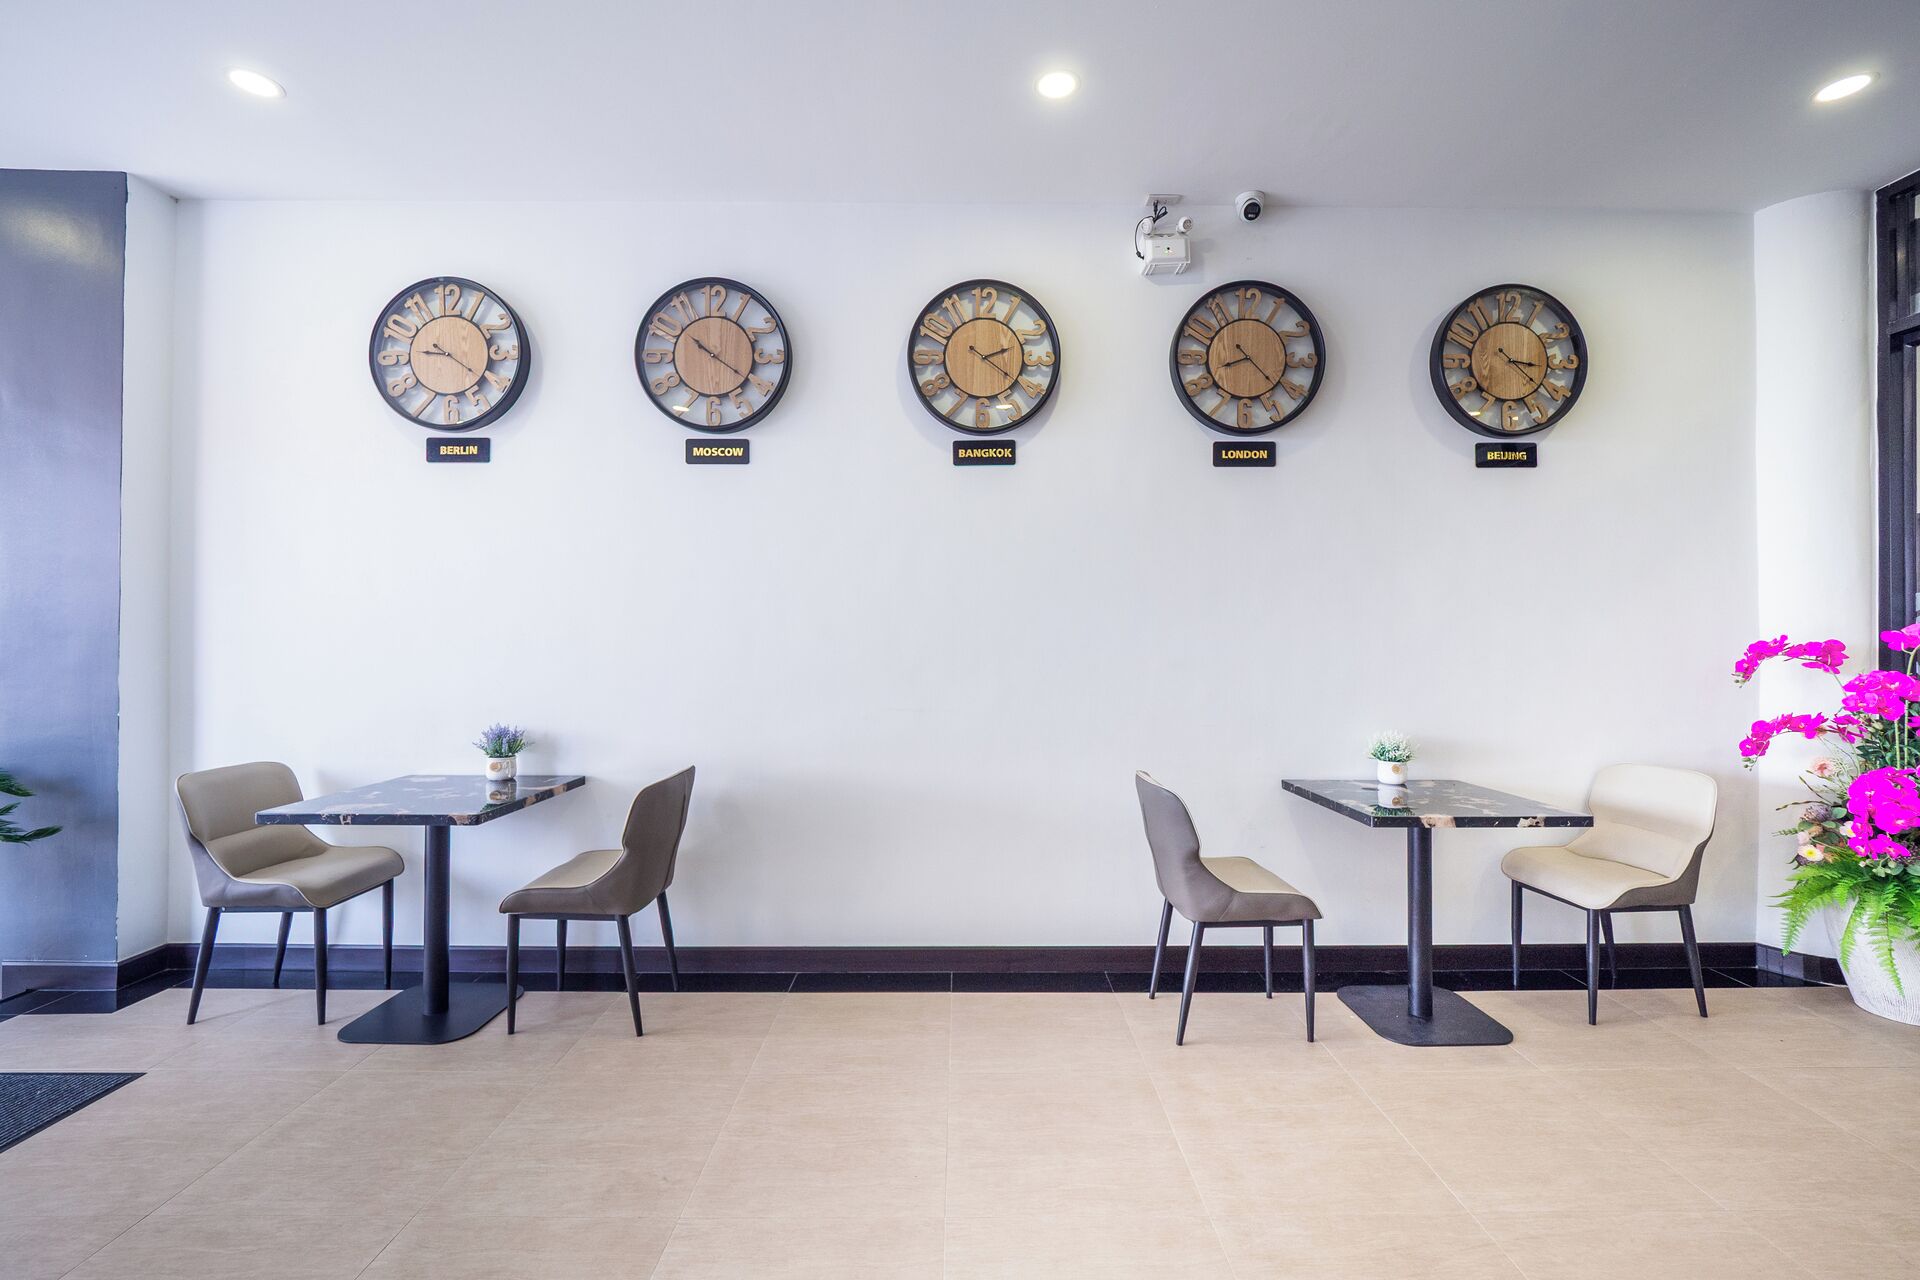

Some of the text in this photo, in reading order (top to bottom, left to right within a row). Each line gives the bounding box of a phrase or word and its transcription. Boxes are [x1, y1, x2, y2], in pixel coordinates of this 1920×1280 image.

[405, 292, 435, 326] 11
[434, 284, 462, 316] 12
[671, 292, 700, 323] 11
[702, 285, 727, 316] 12
[734, 294, 752, 322] 1
[942, 294, 968, 327] 11
[972, 287, 998, 318] 12
[1003, 295, 1022, 324] 1
[1206, 294, 1234, 327] 11
[1235, 288, 1262, 319] 12
[1266, 297, 1285, 324] 1
[1467, 297, 1494, 330] 11
[1496, 291, 1521, 322] 12
[384, 314, 417, 341] 10
[479, 313, 512, 339] 2
[649, 312, 683, 343] 10
[1526, 301, 1545, 328] 1
[746, 317, 777, 342] 2
[920, 313, 952, 345] 10
[1016, 319, 1047, 344] 2
[1184, 315, 1216, 346] 10
[1279, 320, 1311, 344] 2
[1447, 318, 1479, 349] 10
[1539, 323, 1570, 343] 2
[378, 350, 409, 366] 9
[490, 345, 519, 361] 3
[643, 349, 673, 364] 9
[754, 348, 784, 364] 3
[913, 349, 944, 365] 9
[1024, 351, 1055, 366] 3
[1178, 350, 1207, 365] 9
[1286, 352, 1317, 368] 3
[1548, 355, 1579, 369] 3
[387, 373, 417, 397] 8
[651, 373, 681, 395] 8
[748, 373, 773, 397] 4
[921, 373, 950, 397] 8
[1017, 376, 1047, 398] 4
[1185, 373, 1213, 397] 8
[1279, 379, 1309, 400] 4
[1542, 378, 1572, 401] 4
[444, 395, 459, 424] 6
[706, 397, 721, 426] 6
[729, 387, 753, 418] 5
[945, 389, 968, 417] 7
[976, 398, 990, 428] 6
[1209, 388, 1231, 417] 7
[1237, 399, 1252, 428] 6
[1260, 391, 1284, 422] 5
[1501, 401, 1517, 430] 6
[1523, 393, 1548, 424] 5
[440, 446, 477, 455] BERLIN
[693, 448, 744, 456] MOSCOW
[959, 449, 1012, 458] BANGKOK
[1222, 450, 1267, 459] LONDON
[1487, 452, 1527, 460] BEIJING
